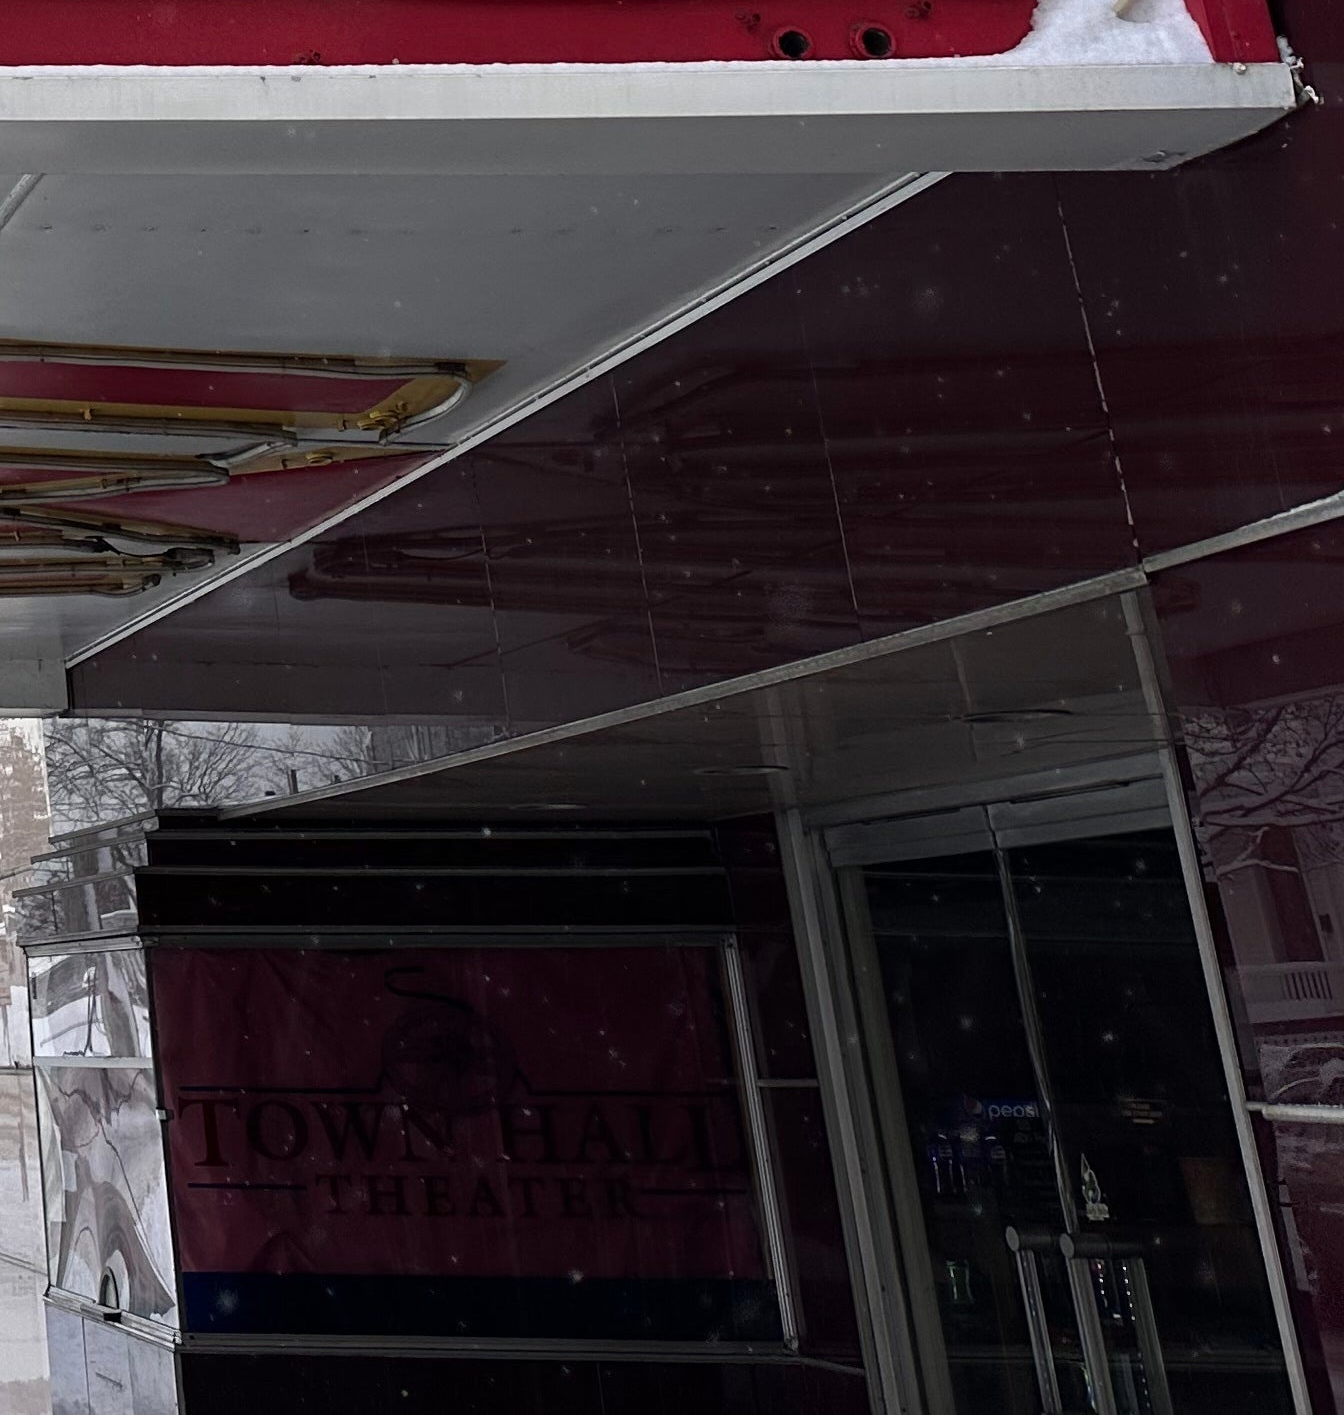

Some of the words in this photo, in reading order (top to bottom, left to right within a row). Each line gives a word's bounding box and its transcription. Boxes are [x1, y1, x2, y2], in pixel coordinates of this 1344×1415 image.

[178, 1096, 463, 1167] TOWN
[496, 1100, 749, 1173] HALL
[315, 1173, 648, 1220] THEATER
